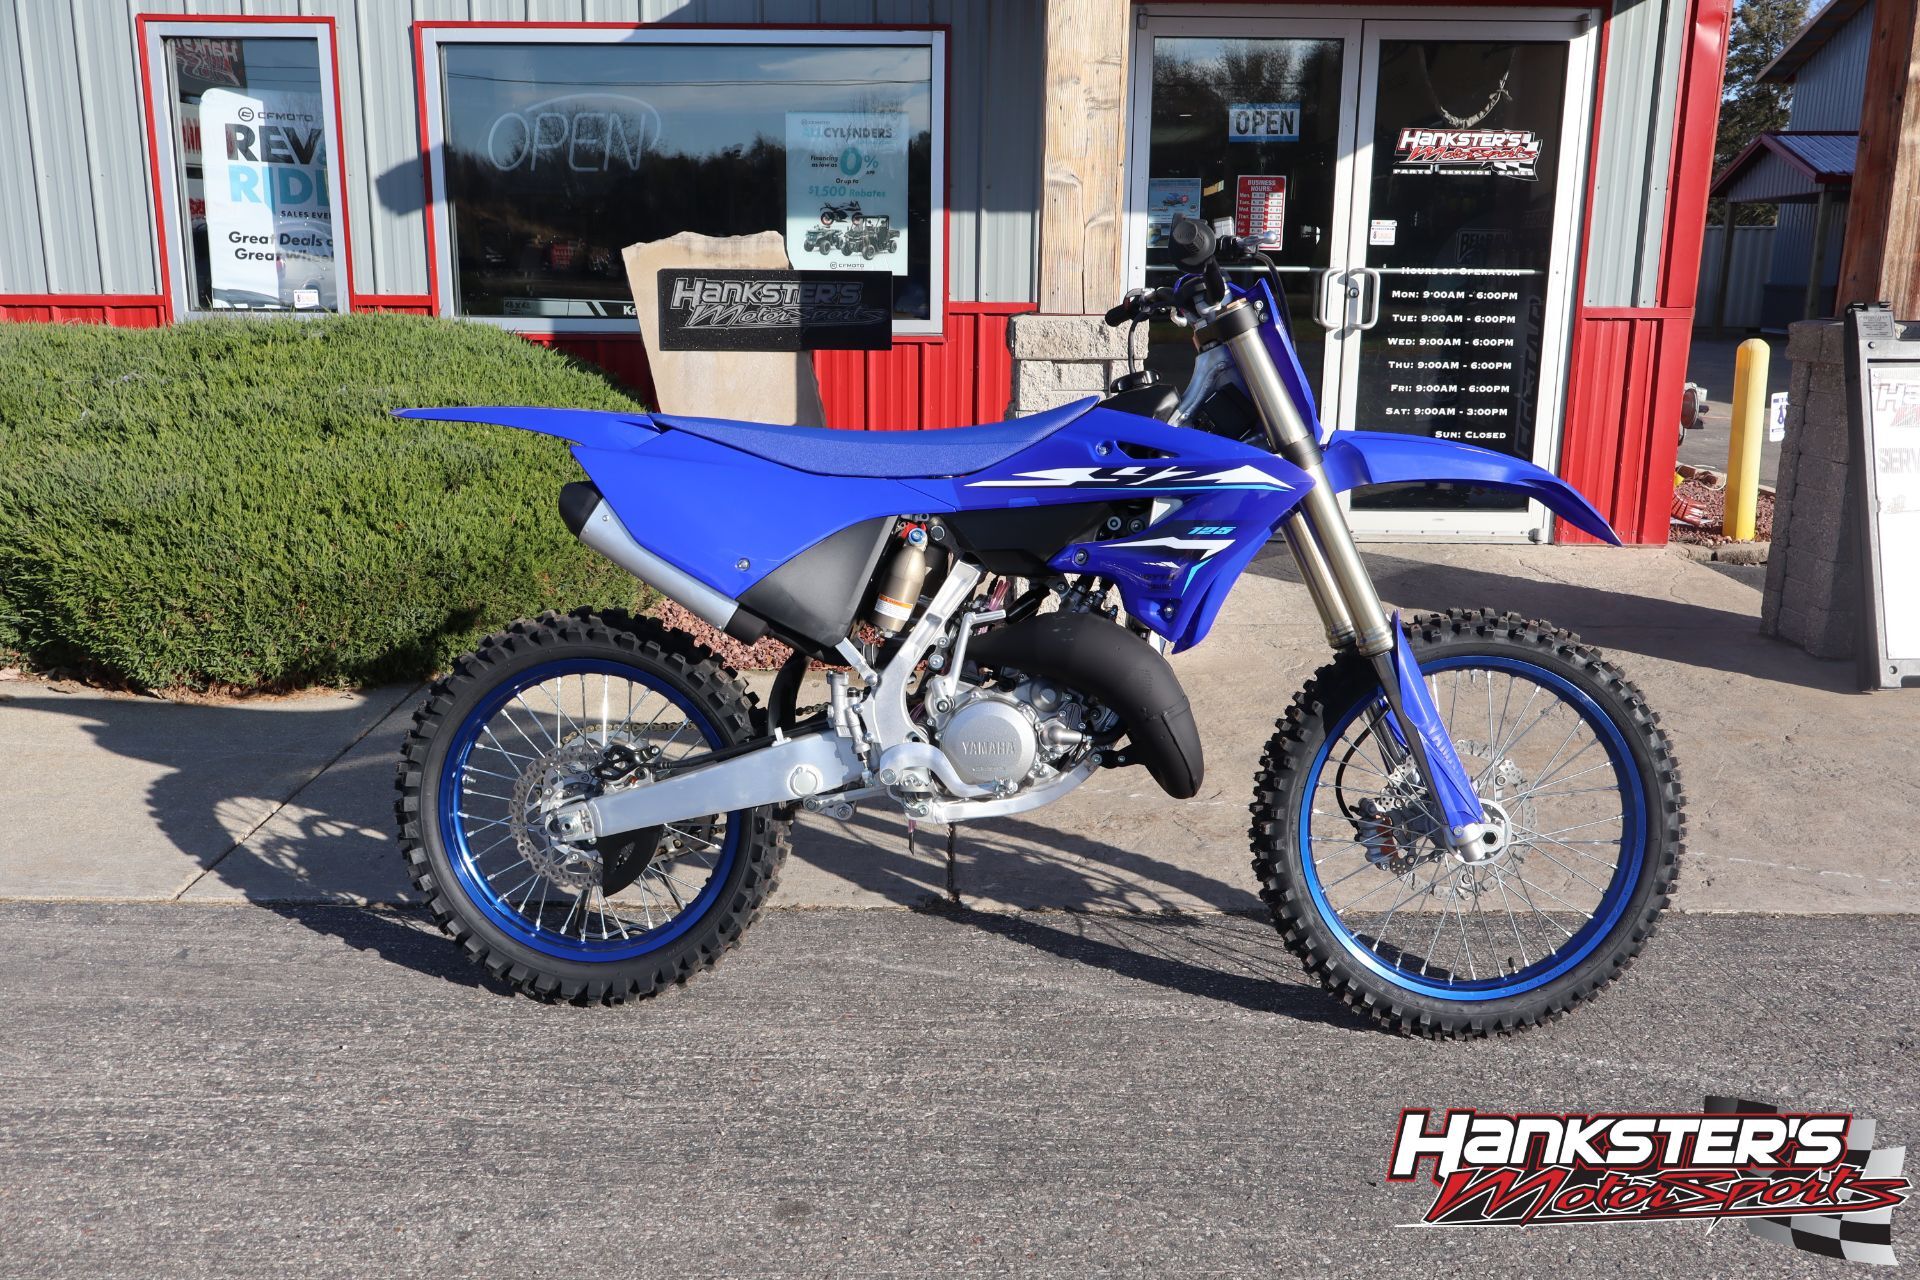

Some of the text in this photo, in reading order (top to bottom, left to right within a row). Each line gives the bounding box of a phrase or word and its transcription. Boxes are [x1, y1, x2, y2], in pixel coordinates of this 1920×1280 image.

[258, 112, 313, 121] CFMOTO
[1235, 110, 1295, 135] OPEN
[225, 123, 322, 165] REV
[488, 112, 646, 171] OPEN
[849, 189, 886, 197] Rebates
[281, 210, 308, 218] SALES
[228, 231, 276, 244] Great
[280, 233, 322, 247] Deals
[1423, 291, 1465, 299] 9:00AM
[1476, 291, 1518, 300] 6:00PM
[1421, 314, 1463, 323] 9:00AM
[1474, 315, 1516, 324] 6:00PM
[1419, 338, 1461, 346] 9:00AM
[1472, 338, 1514, 347] 6:00PM
[1417, 361, 1459, 370] 9:00AM
[1470, 362, 1512, 370] 6:00PM
[1415, 384, 1457, 393] 9:00AM
[1468, 385, 1510, 393] 6:00PM
[1414, 408, 1456, 416] 9:00AM
[1466, 408, 1508, 416] 3:00PM
[1187, 526, 1237, 535] 125
[962, 741, 1015, 755] YAMAHA
